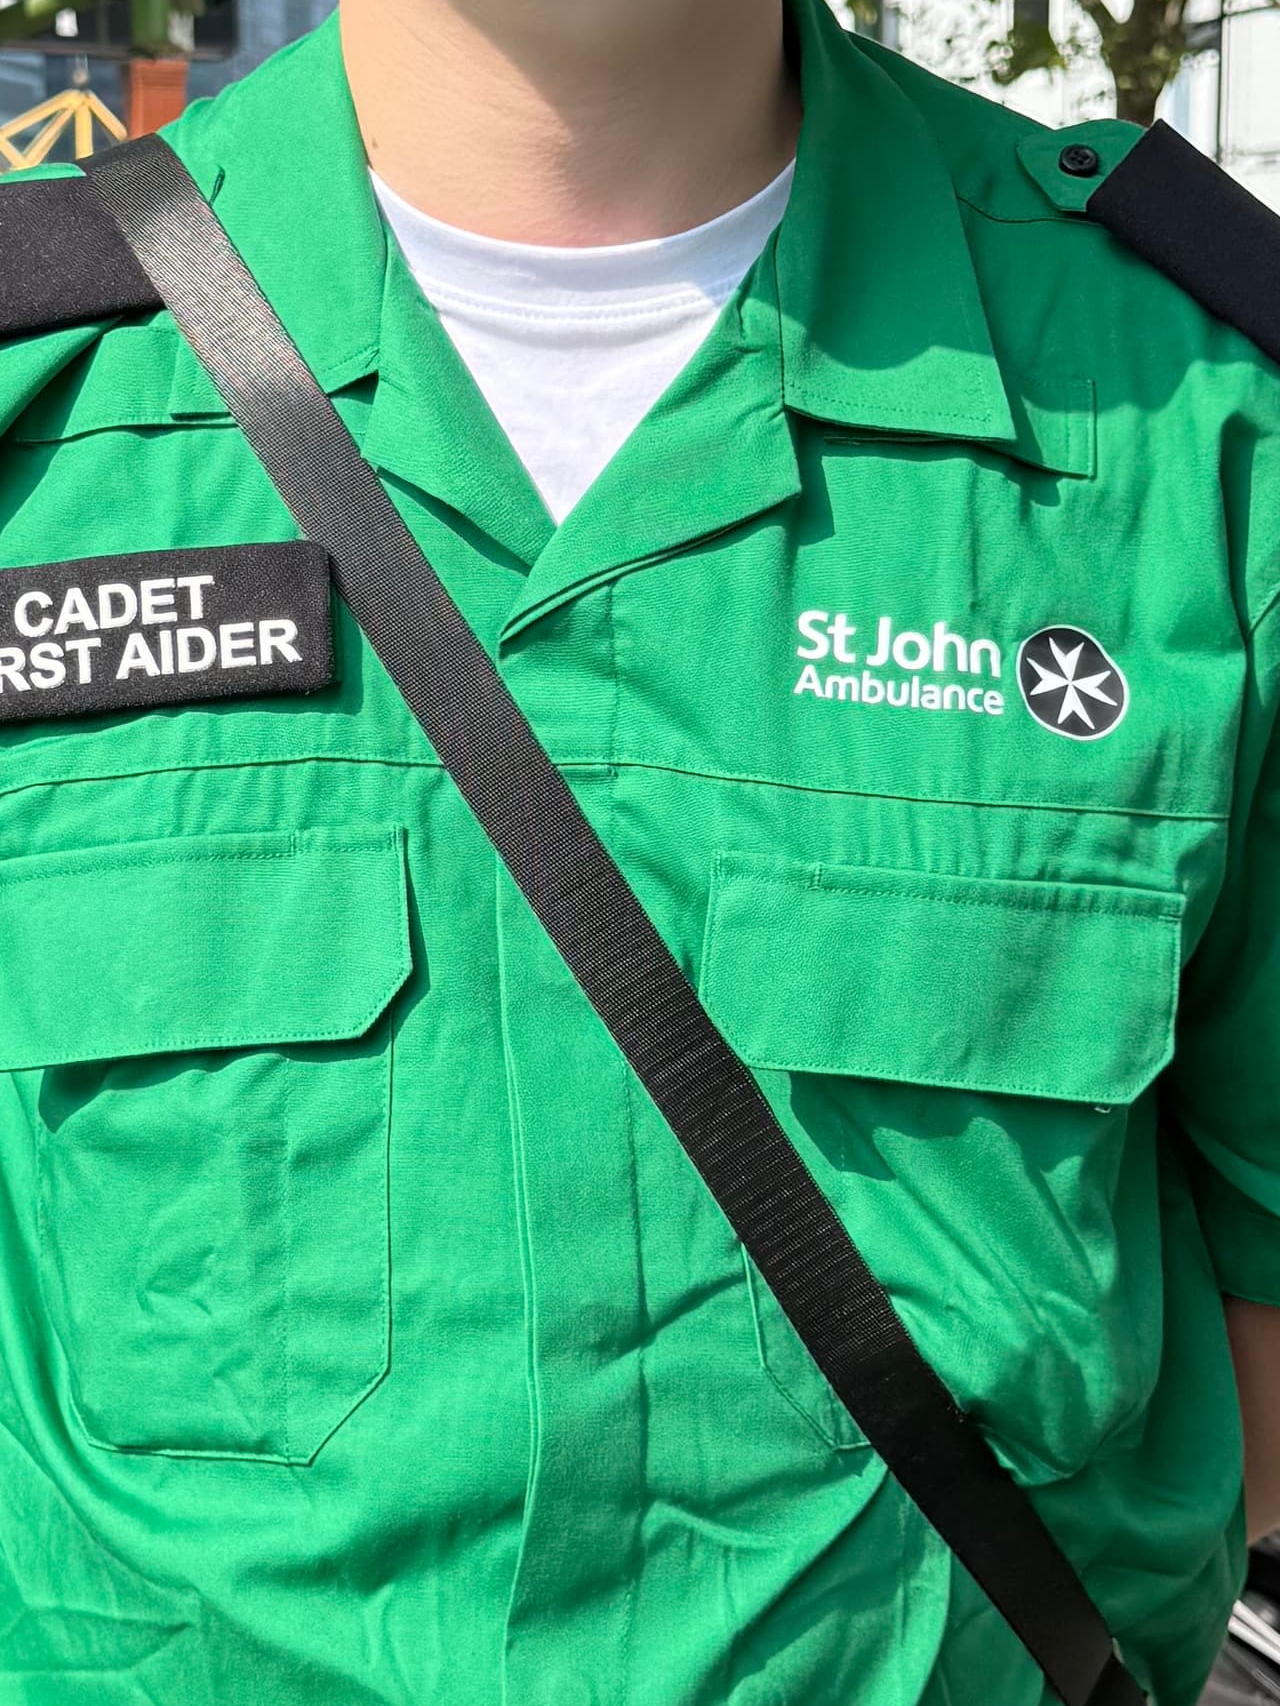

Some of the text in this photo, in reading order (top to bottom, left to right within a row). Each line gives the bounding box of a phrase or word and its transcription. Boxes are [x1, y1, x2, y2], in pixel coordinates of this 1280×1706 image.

[13, 574, 216, 638] CADET
[114, 617, 304, 680] AIDER
[796, 609, 1002, 678] St John
[792, 663, 1005, 716] Ambulance
